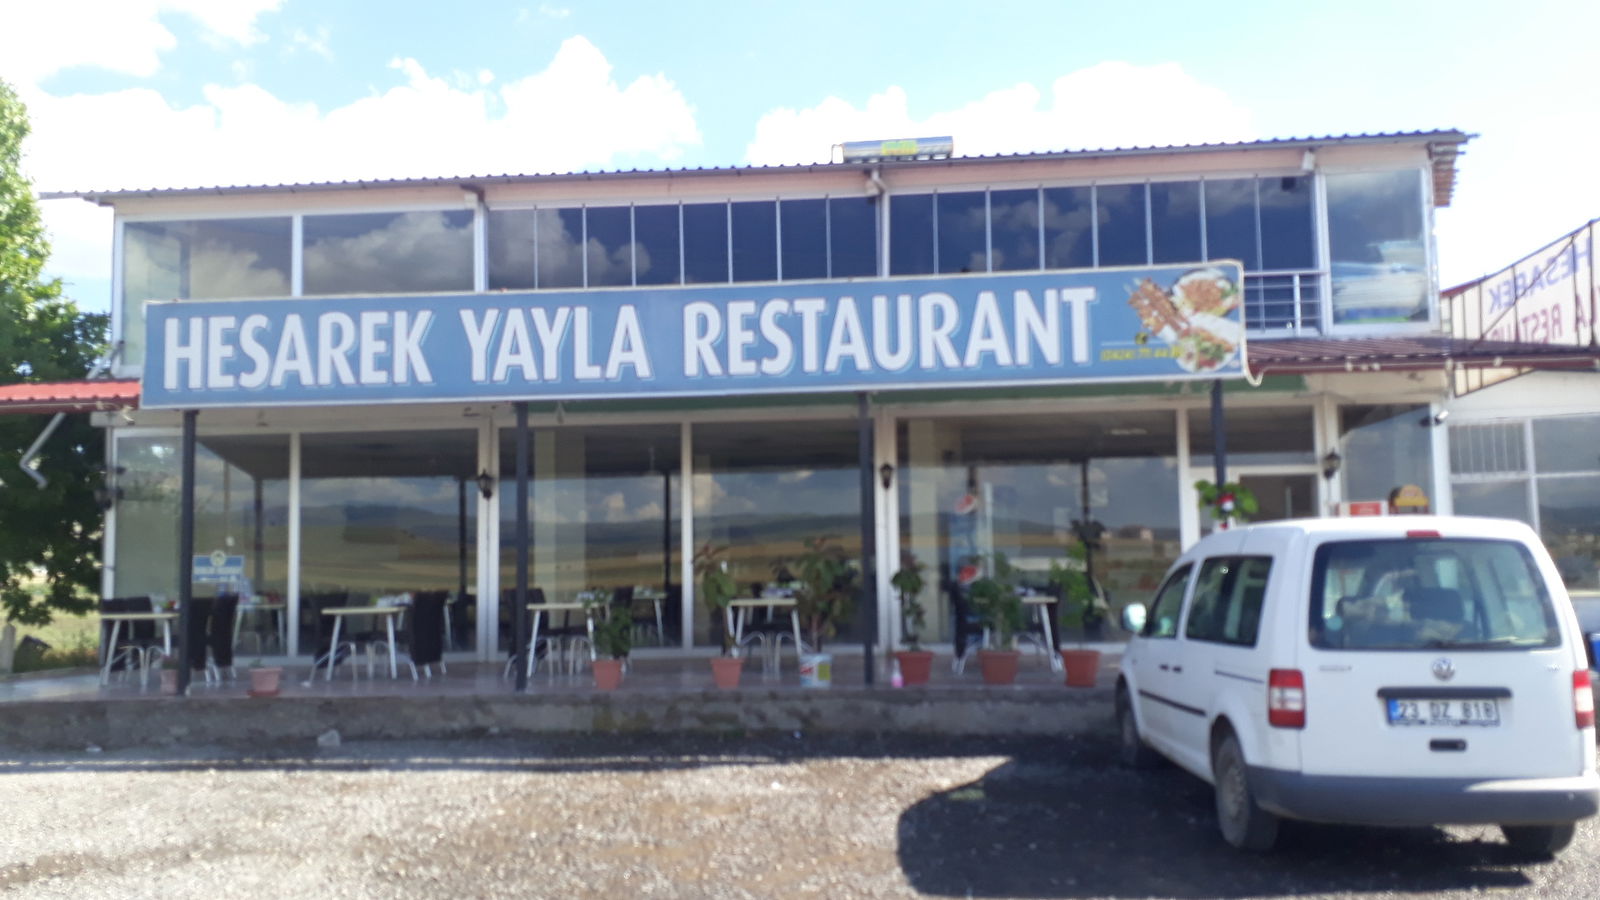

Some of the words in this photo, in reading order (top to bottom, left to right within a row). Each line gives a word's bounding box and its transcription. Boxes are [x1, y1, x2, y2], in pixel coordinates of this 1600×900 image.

[164, 310, 433, 390] HESAREK
[459, 304, 651, 382] YAYLA
[683, 286, 1097, 377] RESTAURANT
[1399, 702, 1418, 719] 23
